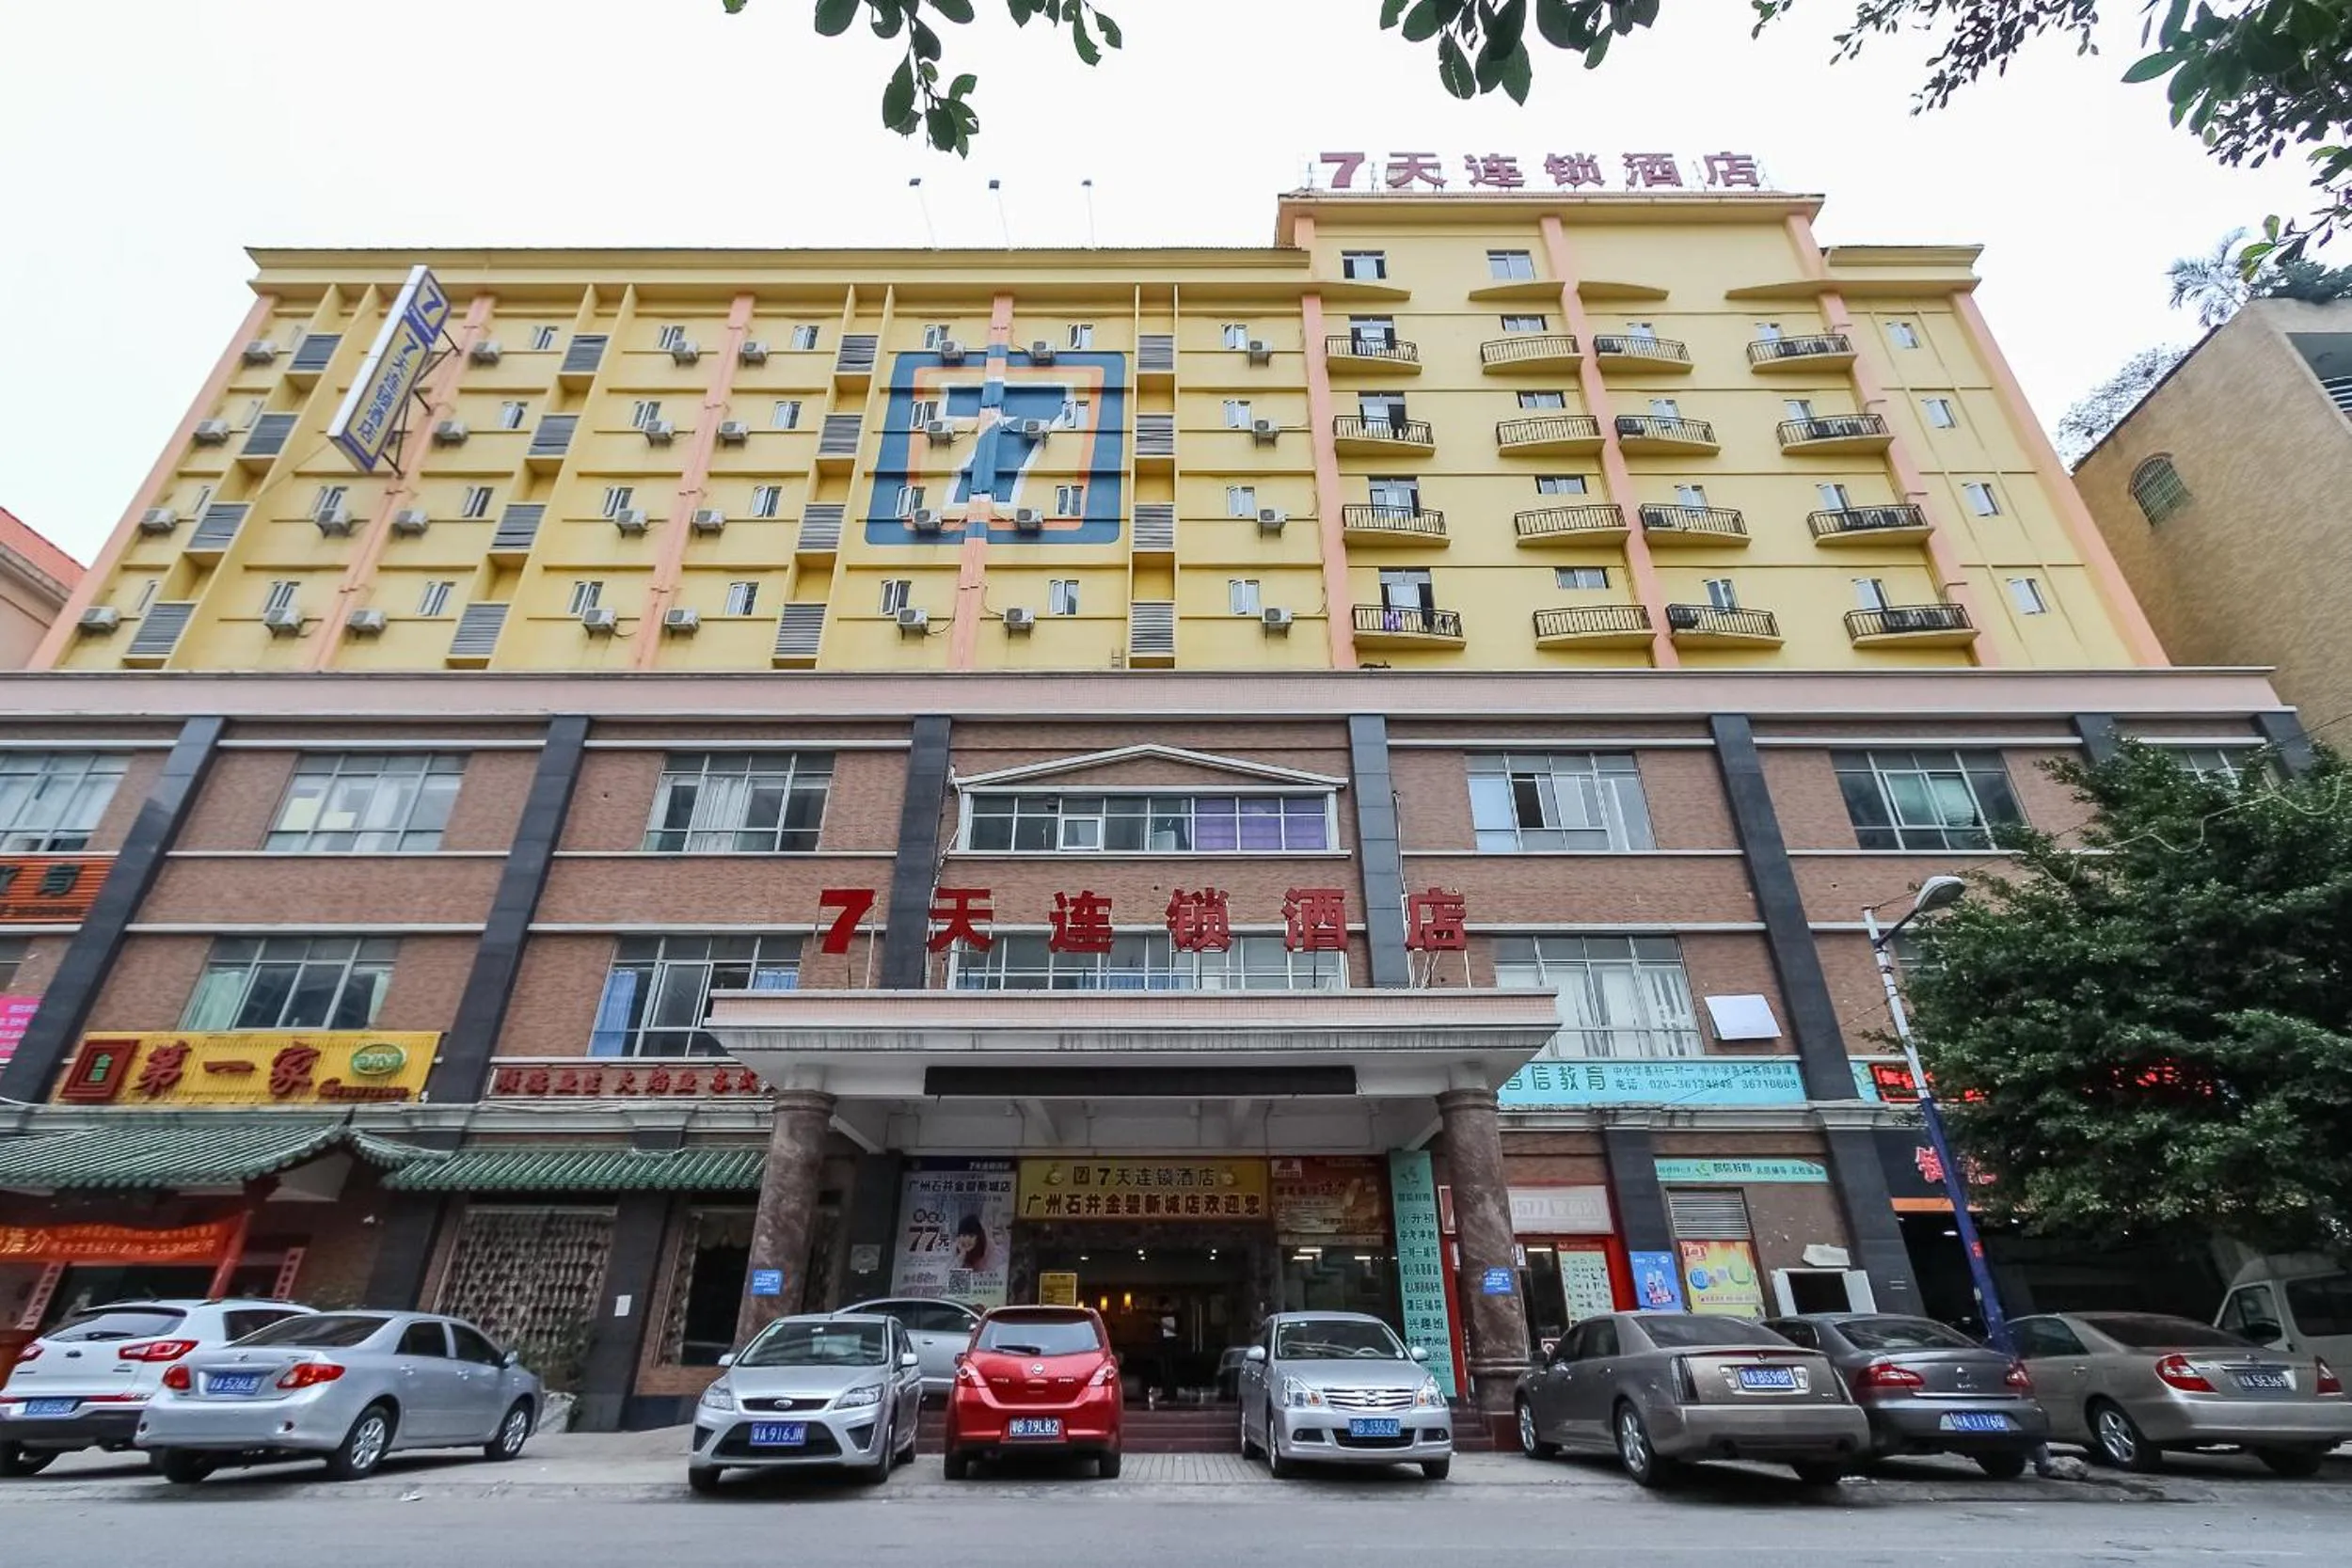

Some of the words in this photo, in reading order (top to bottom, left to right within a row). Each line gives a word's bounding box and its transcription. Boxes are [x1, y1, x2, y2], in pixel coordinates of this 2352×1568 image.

[1320, 151, 1760, 188] 7天连锁酒店
[819, 888, 1468, 954] 7天连锁酒店
[1097, 1167, 1216, 1187] 7天连锁酒店
[1025, 1194, 1262, 1214] 广州石井金碧新城店欢迎您
